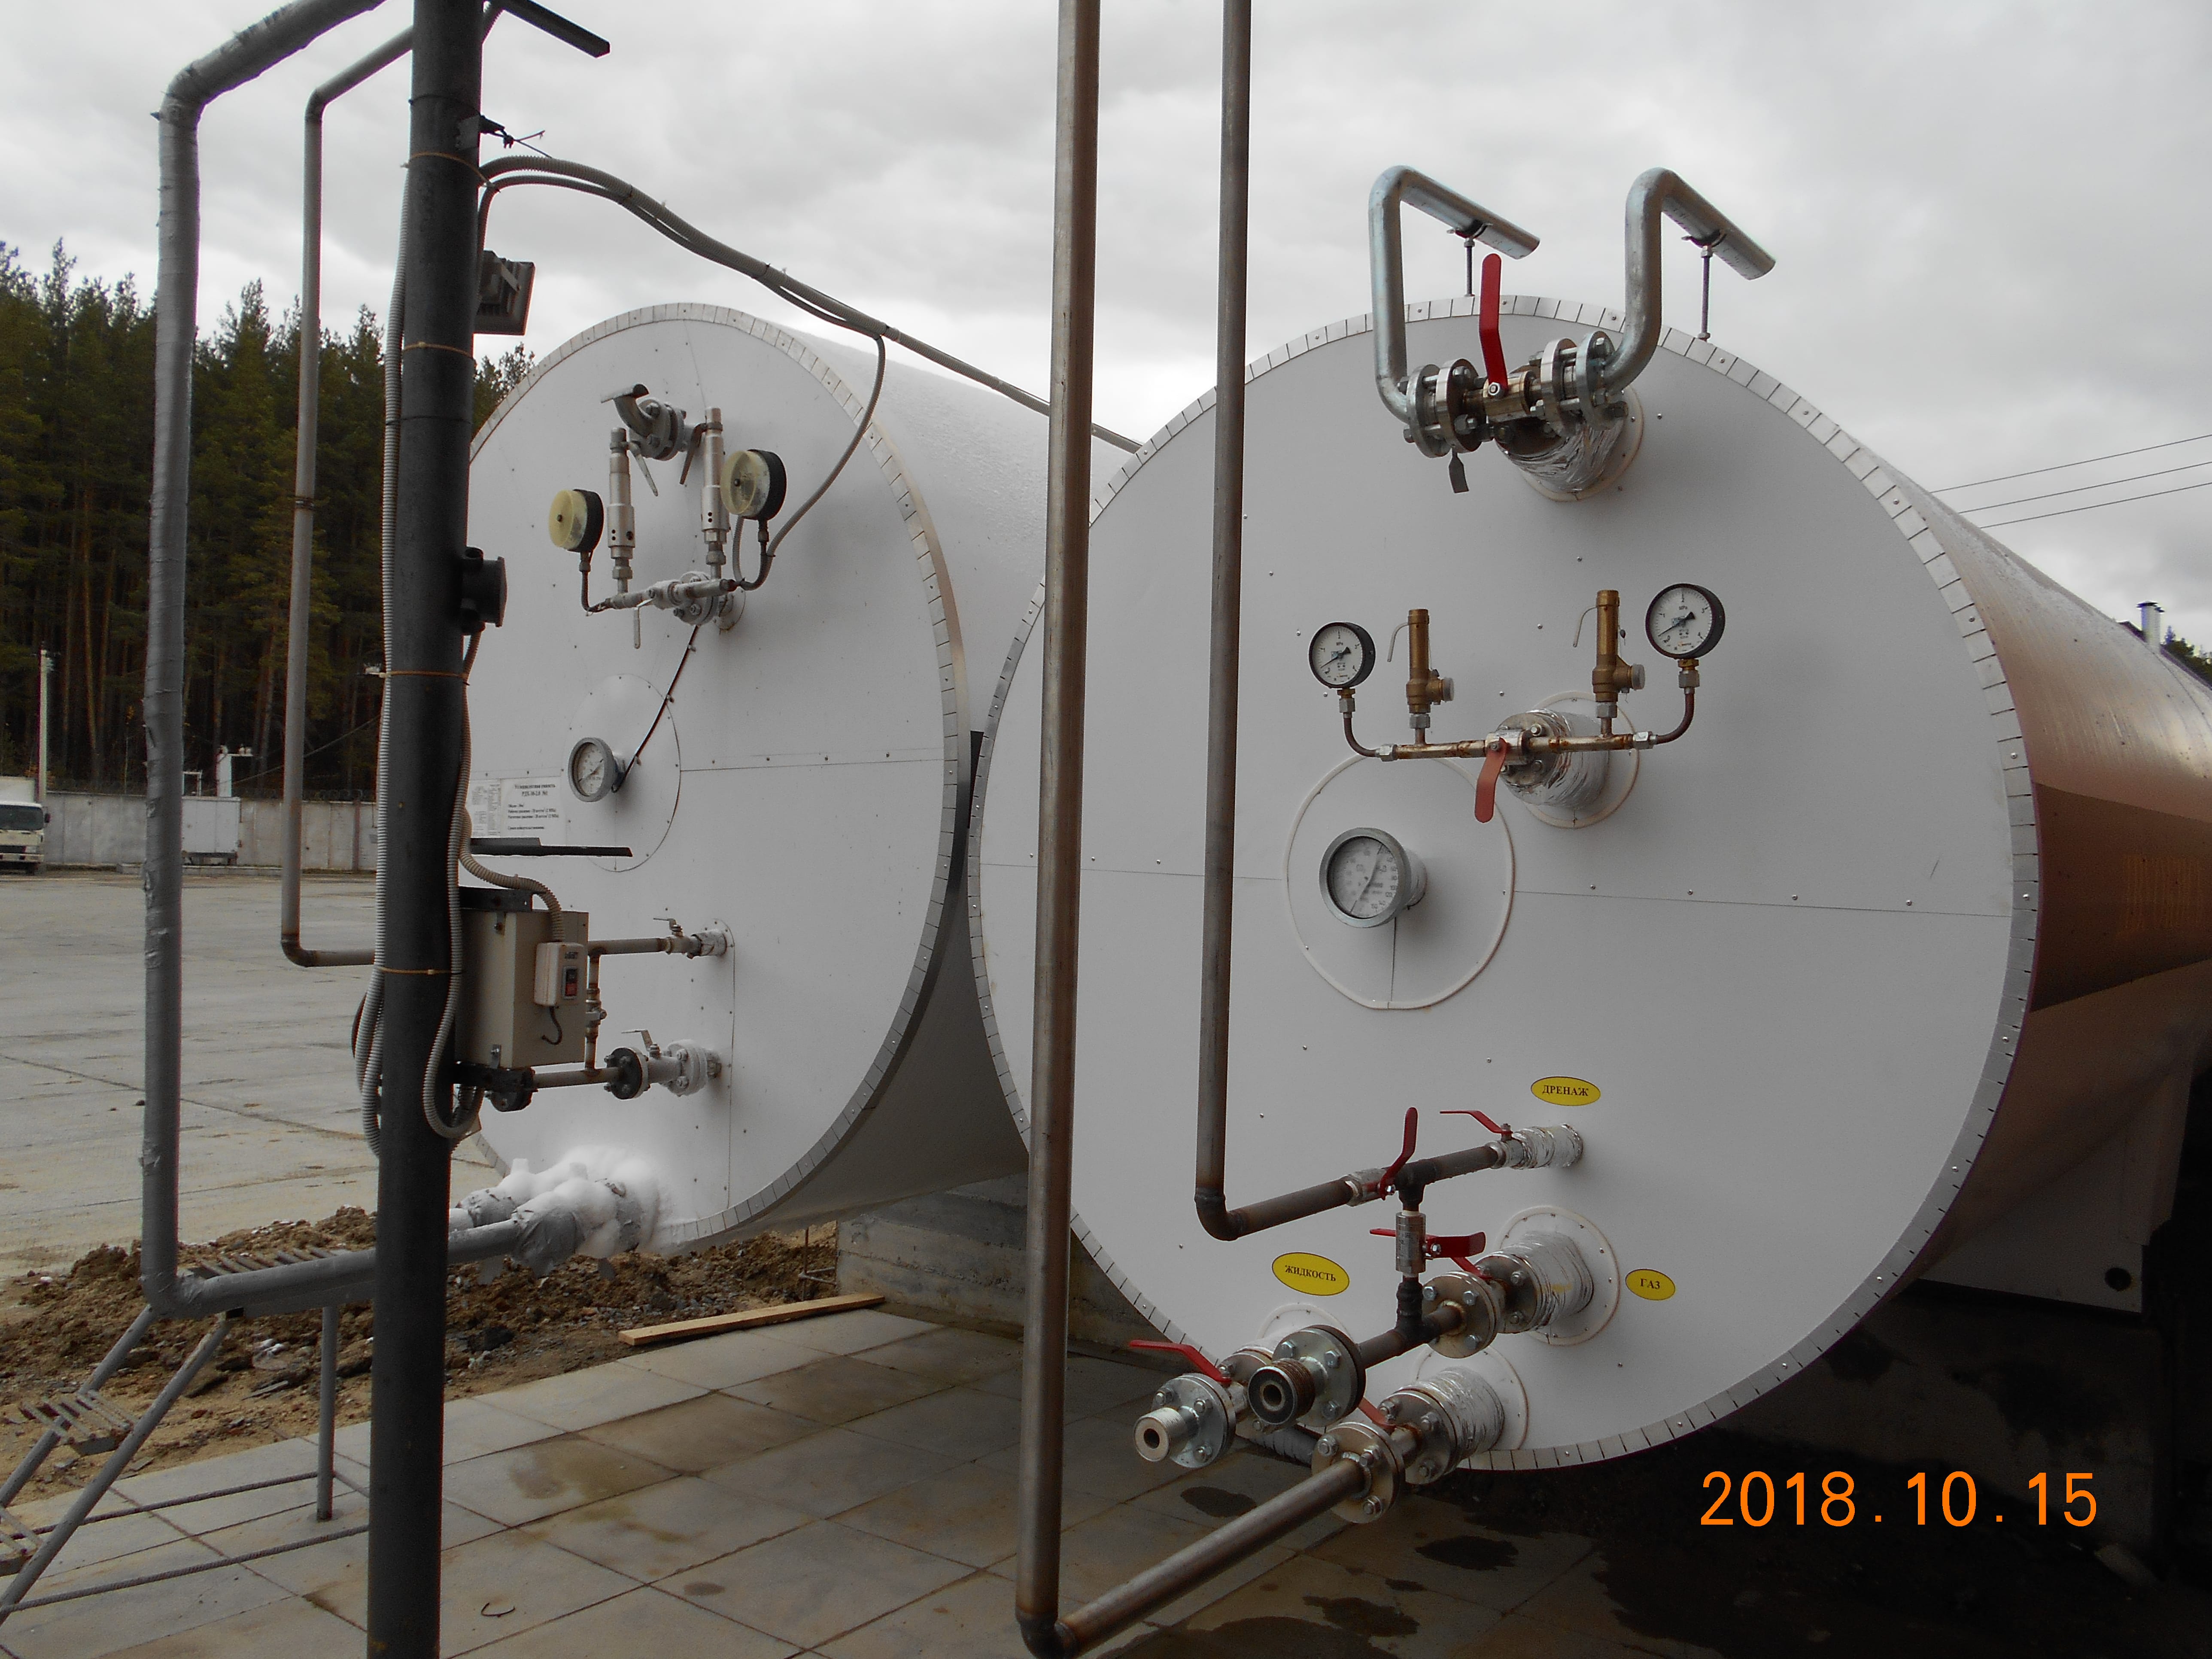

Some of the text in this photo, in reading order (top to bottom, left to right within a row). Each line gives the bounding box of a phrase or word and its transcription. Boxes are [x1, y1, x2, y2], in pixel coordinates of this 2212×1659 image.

[1542, 1085, 1589, 1096] ДРЕНАЖ
[1285, 1265, 1336, 1282] ЖИДКОСТЬ
[1640, 1278, 1660, 1290] ГАЗ
